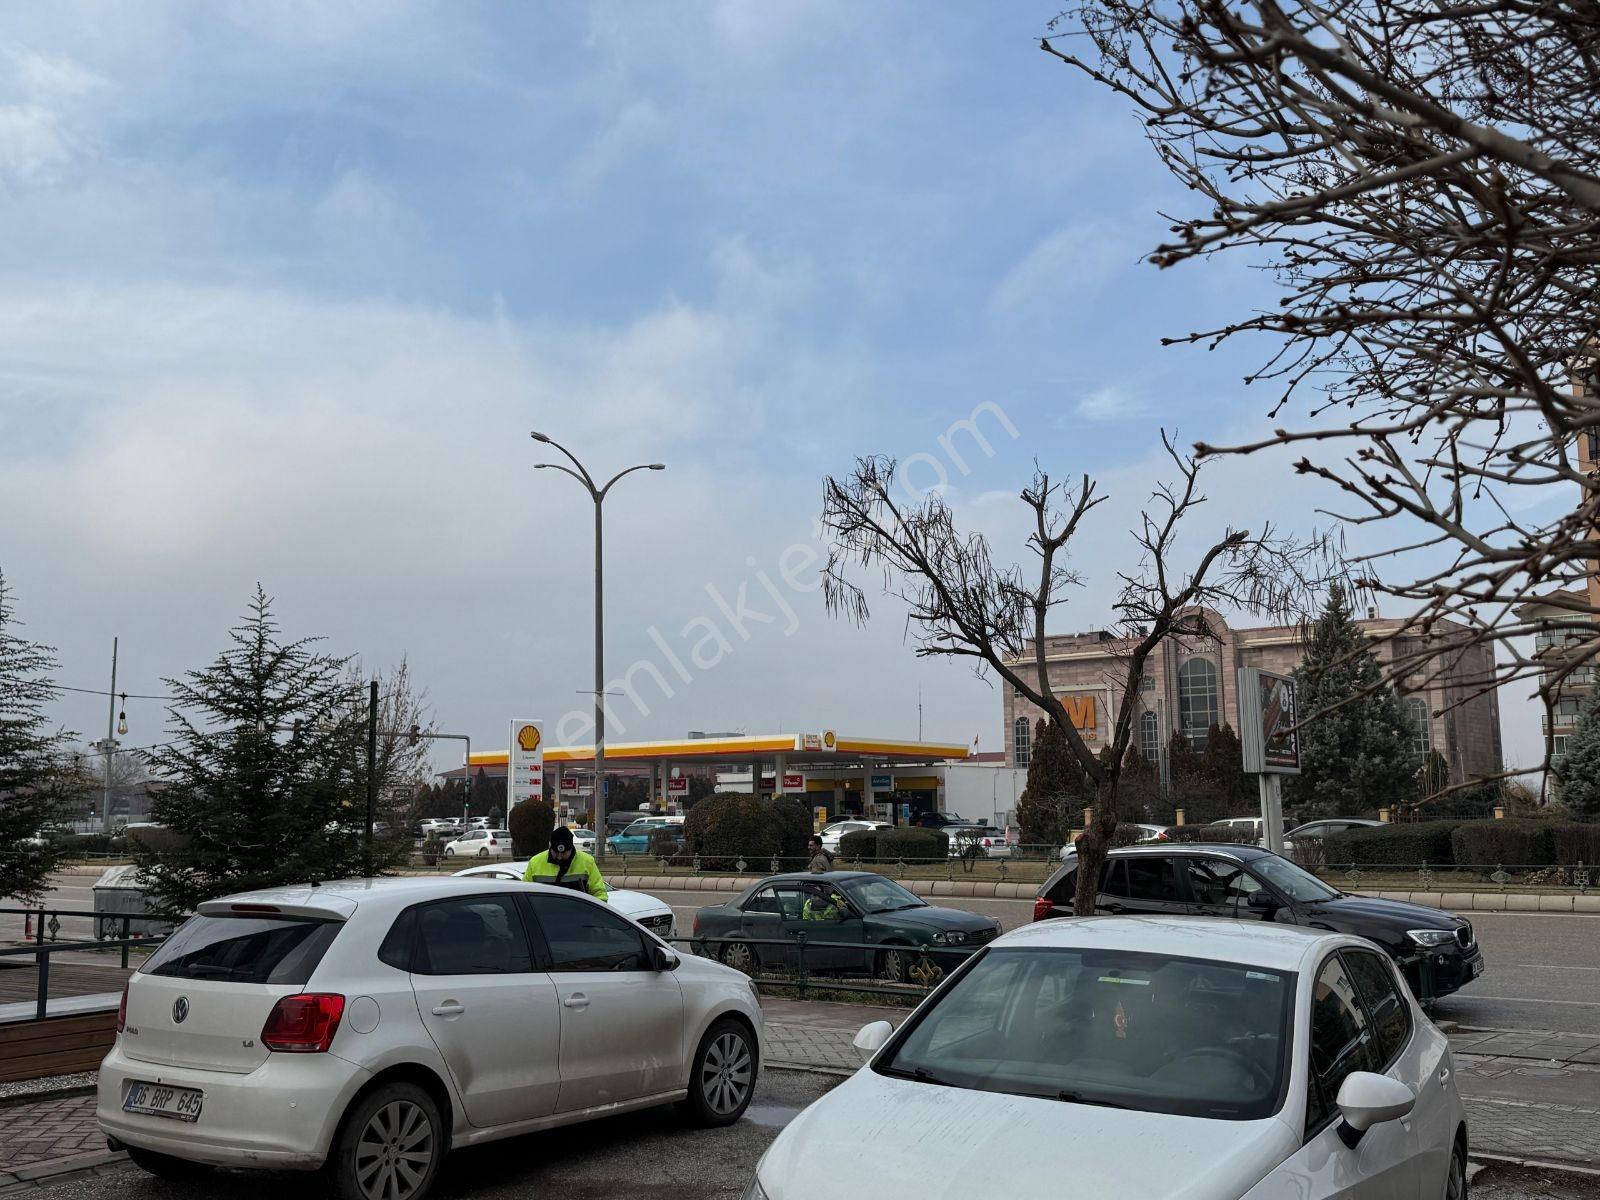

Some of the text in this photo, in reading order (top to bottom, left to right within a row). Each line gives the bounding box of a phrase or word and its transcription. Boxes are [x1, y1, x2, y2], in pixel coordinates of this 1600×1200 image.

[1059, 696, 1096, 729] M
[134, 1086, 149, 1105] 06
[150, 1089, 174, 1109] BRP
[177, 1092, 203, 1113] 645
